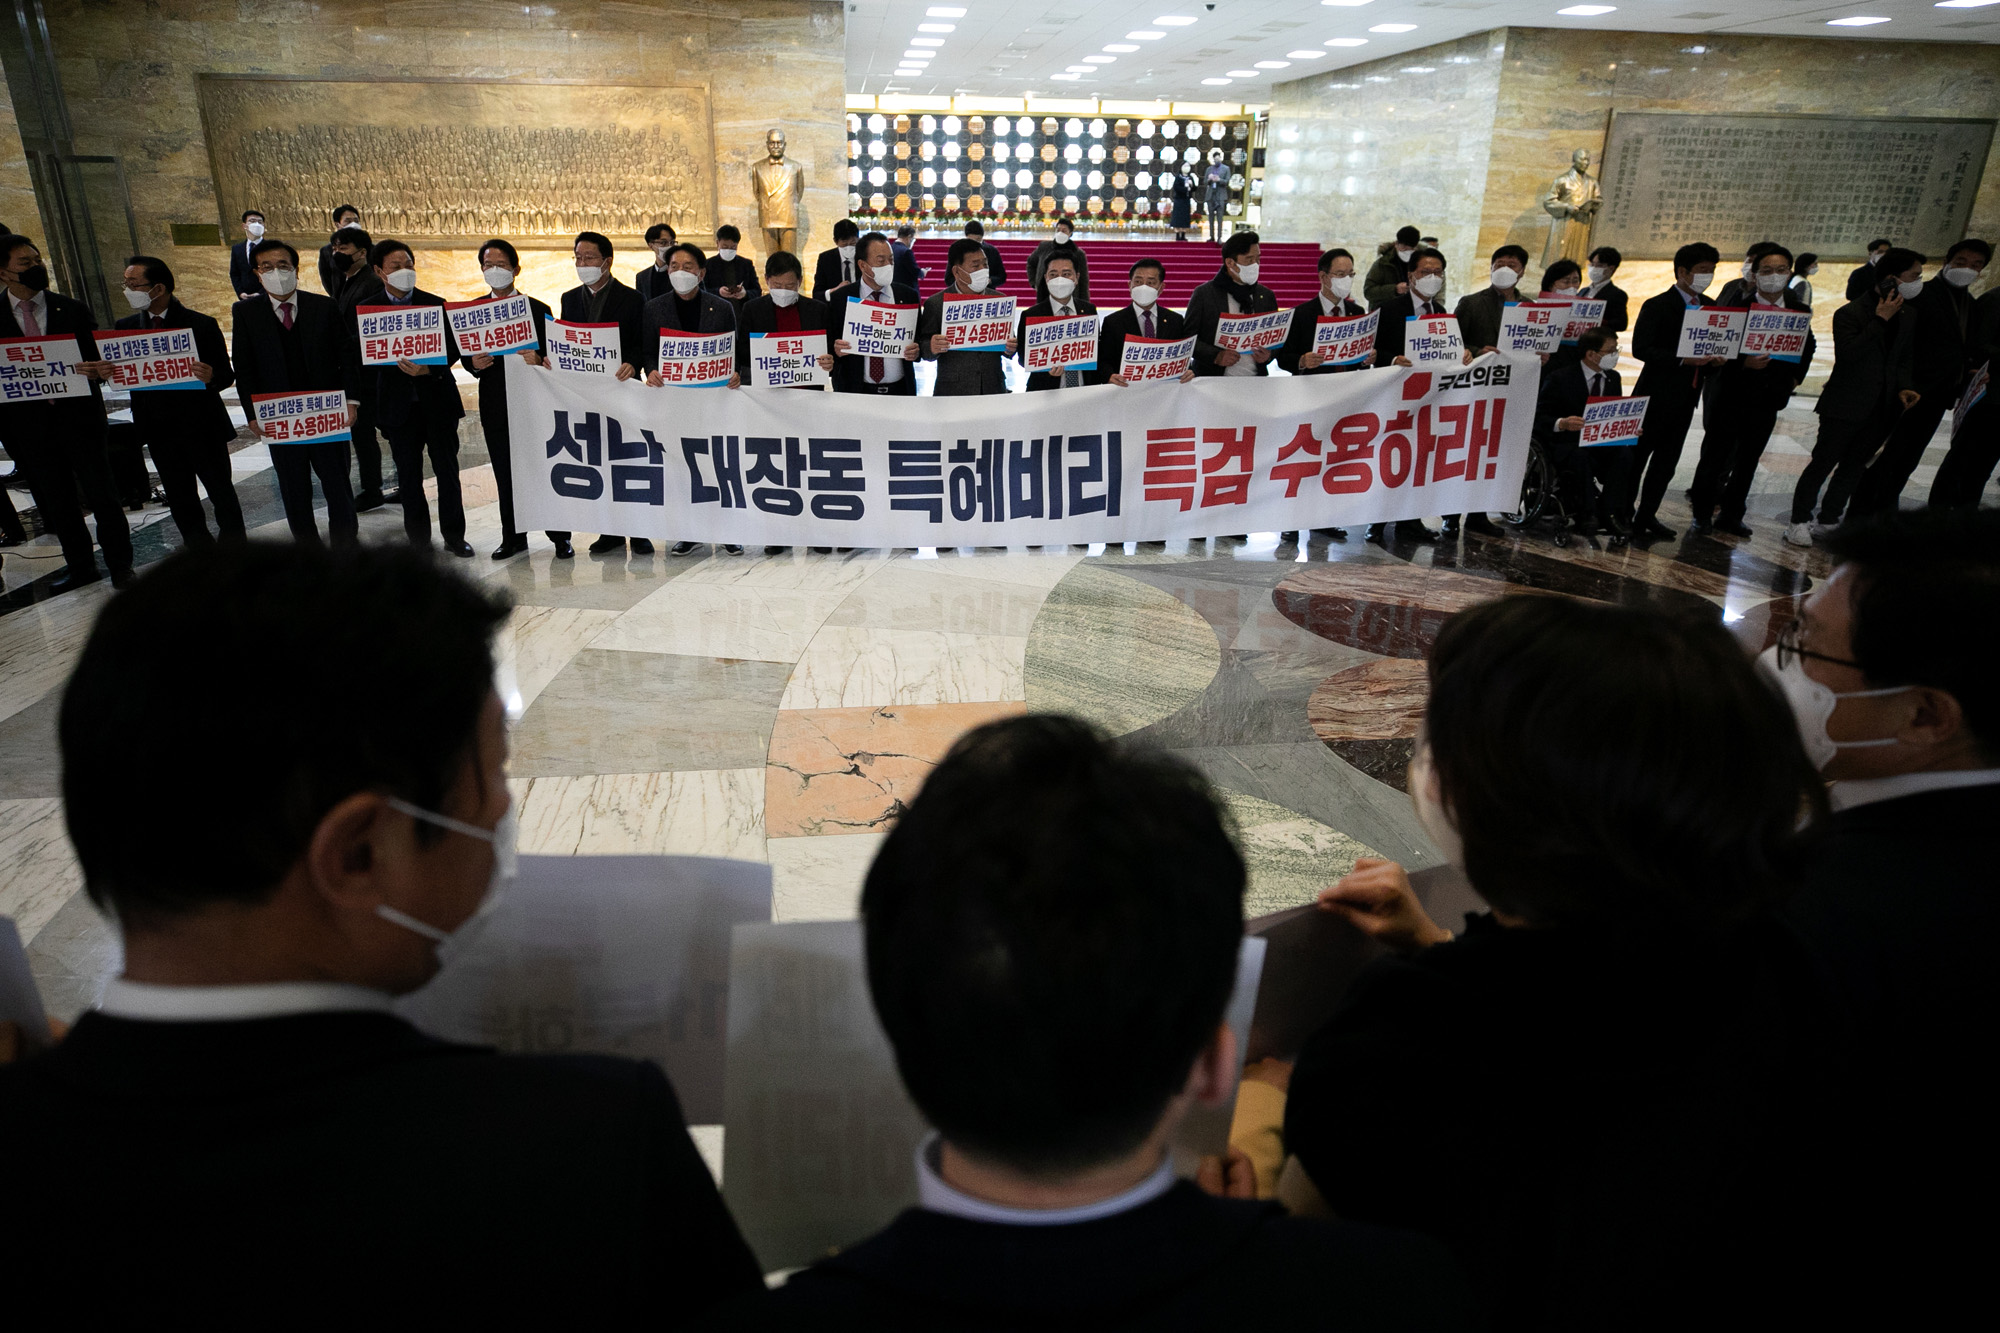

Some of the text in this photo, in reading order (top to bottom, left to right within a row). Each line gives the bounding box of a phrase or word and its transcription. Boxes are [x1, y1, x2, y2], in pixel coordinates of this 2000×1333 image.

[453, 298, 526, 329] 성남 대장동 특혜 비리
[871, 310, 897, 326] 특검
[945, 300, 1014, 321] 성남 대장동 특혜 비리
[1527, 311, 1550, 324] 특검
[362, 310, 439, 334] 성남 대장동 특혜 비리
[1220, 312, 1291, 332] 성남 대장동 특혜 비리
[1318, 326, 1334, 341] 성남
[1334, 323, 1355, 338] 대장동
[1356, 318, 1368, 335] 특혜
[1428, 321, 1447, 335] 특검
[1708, 314, 1729, 328] 특검
[1748, 314, 1762, 328] 성남
[1762, 314, 1782, 330] 대장동
[1783, 315, 1796, 330] 특혜
[459, 321, 533, 351] 특검 수용하라!
[565, 330, 592, 345] 특검
[848, 322, 913, 340] 거부하는 자가
[946, 322, 1012, 345] 특검 수용하라!
[1028, 319, 1096, 344] 성남 대장동 특혜 비리
[1218, 328, 1286, 350] 특검 수용하라!
[1504, 325, 1544, 338] 거부하는
[1545, 325, 1562, 338] 자가
[1686, 328, 1740, 342] 거부하는 자가
[103, 333, 191, 360] 성남 대장동 특혜 비리
[366, 333, 441, 360] 특검 수용하라!
[548, 339, 617, 360] 거부하는 자가
[662, 335, 732, 357] 성남 대장동 특혜 비리
[777, 340, 803, 355] 특검
[858, 339, 901, 354] 범인이다
[1125, 339, 1193, 361] 성남 대장동 특혜 비리
[1409, 337, 1447, 351] 거부하는
[1513, 338, 1550, 350] 범인이다
[1694, 342, 1728, 355] 범인이다
[1745, 333, 1803, 352] 특검 수용하라!
[6, 346, 45, 362] 특검
[1029, 340, 1095, 367] 특검 수용하라!
[1317, 343, 1339, 362] 특검
[559, 357, 605, 373] 범인이다
[662, 357, 732, 381] 특검 수용하라!
[755, 355, 820, 370] 거부하는 자
[1123, 357, 1189, 382] 특검 수용하라!
[0, 365, 46, 380] 부하는
[113, 364, 139, 386] 특검
[768, 370, 813, 385] 범인이다
[3, 381, 67, 399] 범인이다
[259, 394, 342, 418] 성남 대장동 특혜 비리
[1585, 407, 1599, 421] 성남
[1598, 404, 1618, 420] 대장동
[1617, 403, 1631, 416] 특혜
[265, 412, 345, 440] 특검 수용하라!
[1583, 419, 1640, 442] 특검 수용하라!
[546, 398, 1506, 523] 성남 대장동 특혜비리 특검 수용하라!
